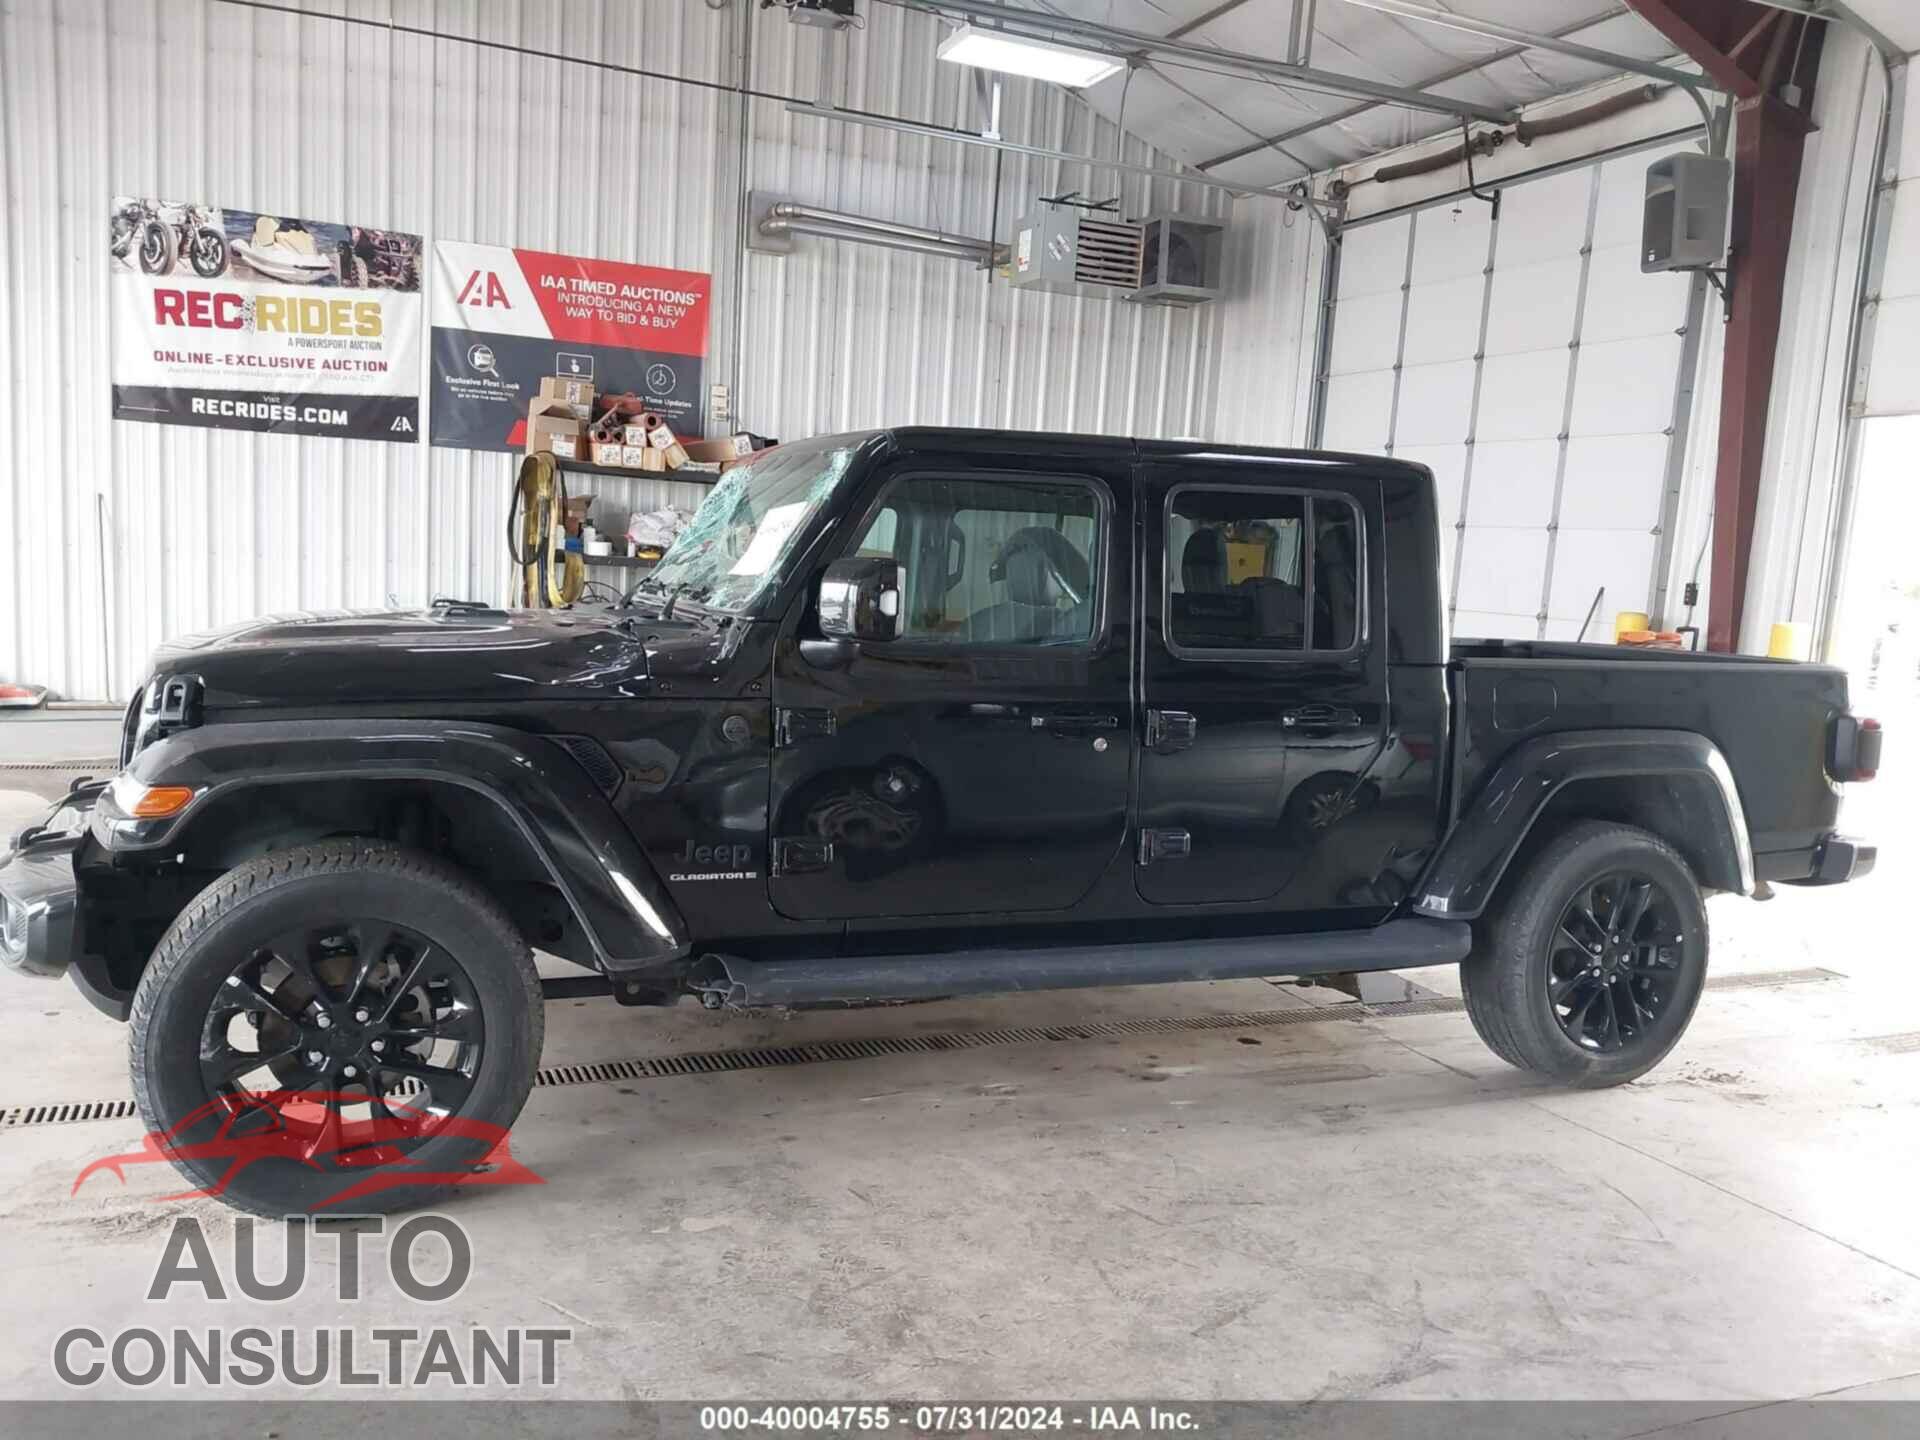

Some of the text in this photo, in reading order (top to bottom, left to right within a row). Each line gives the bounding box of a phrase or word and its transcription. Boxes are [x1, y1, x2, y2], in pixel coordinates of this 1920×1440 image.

[540, 275, 567, 290] IAA
[570, 278, 616, 295] TIMED
[154, 288, 383, 337] REC RIDES
[557, 292, 687, 317] INTRODUCING A NEW
[565, 307, 678, 328] WAY TO BID & BUY
[288, 337, 382, 351] A POWERSPORT AUCTION
[153, 350, 388, 372] ONLINE-EXCLUSIVE AUCTION
[445, 376, 481, 386] Exclusive
[482, 379, 500, 388] First
[191, 397, 349, 426] RECRIDES.COM
[673, 840, 751, 868] Jeep
[669, 871, 744, 881] GLADIATOR
